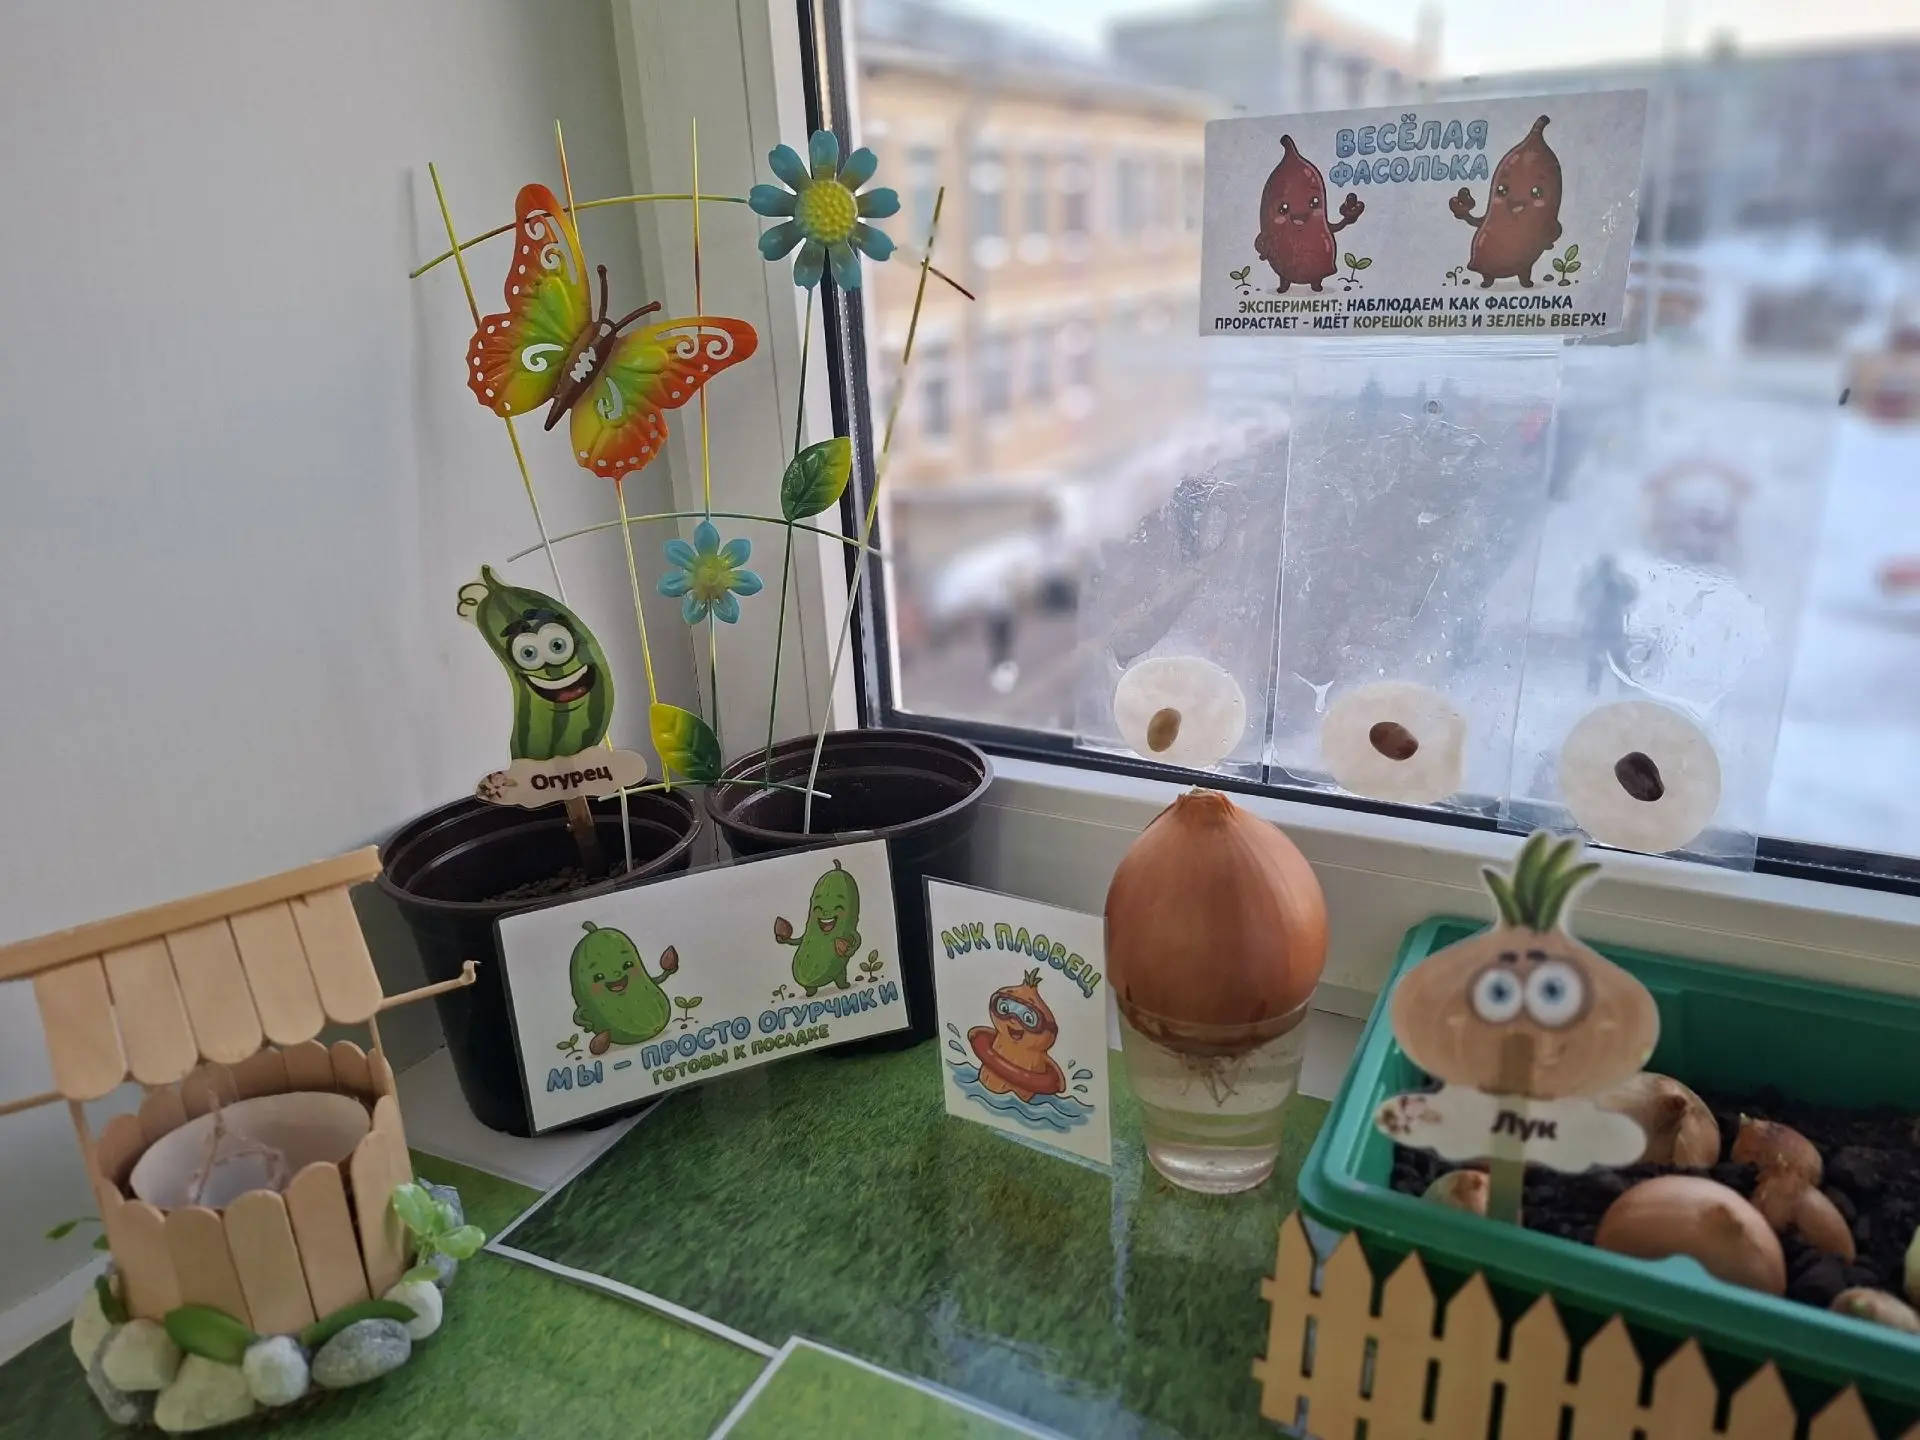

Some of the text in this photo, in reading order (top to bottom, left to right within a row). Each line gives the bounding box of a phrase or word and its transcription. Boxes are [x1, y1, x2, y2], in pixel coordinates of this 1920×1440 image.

[1335, 113, 1489, 159] ВЕСЁЛАЯ
[1328, 153, 1489, 188] ФАСОЛЬКА
[1214, 316, 1299, 330] ПРОРАСТАЕТ
[1313, 313, 1350, 330] ИДЁТ
[1353, 315, 1423, 329] КОРЕШОК
[1427, 314, 1467, 328] ВНИЗ
[1471, 314, 1483, 328] И
[1486, 313, 1546, 328] ЗЕЛЕНЬ
[1550, 312, 1606, 327] ВВЕРХ!
[1238, 294, 1573, 314] ЭКСПЕРИМЕНТ: НАБЛЮДАЕМ КАК ФАСОЛЬКА
[530, 765, 613, 791] Огурец
[941, 921, 1102, 999] ЛУК ПЛОВЕЦ
[546, 1060, 604, 1092] МЫ
[640, 1015, 751, 1070] ПРОСТО
[652, 1023, 830, 1086] ГОТОВЫ К ПОСАДКЕ
[1490, 1109, 1558, 1142] Лук
